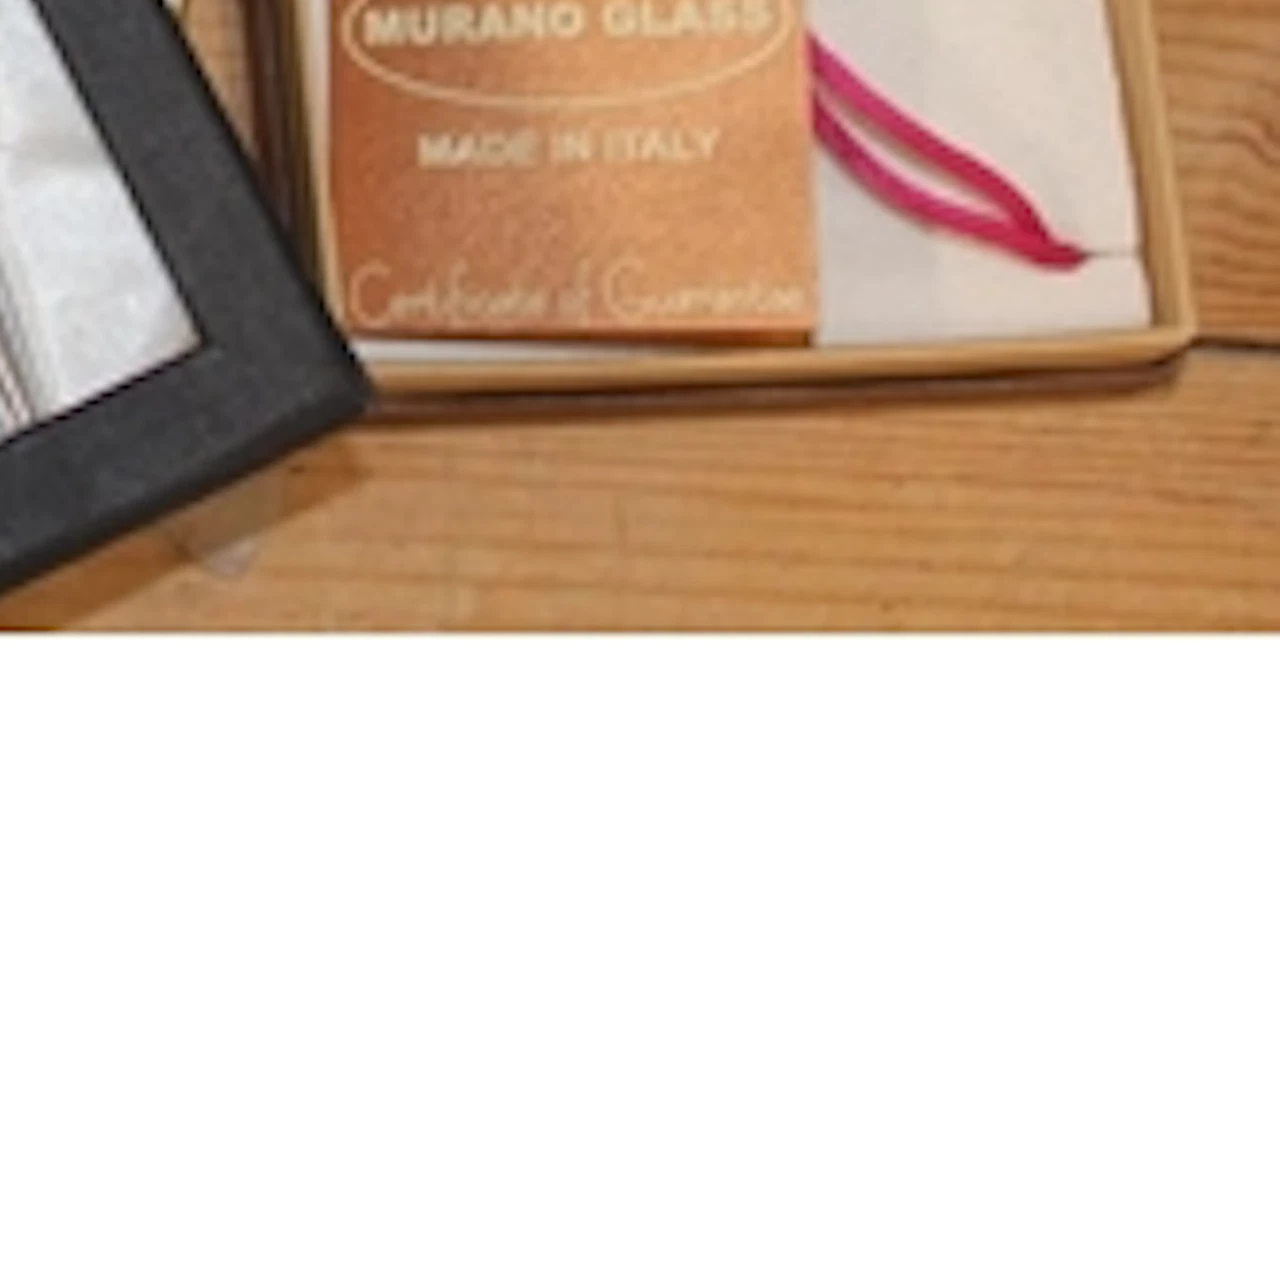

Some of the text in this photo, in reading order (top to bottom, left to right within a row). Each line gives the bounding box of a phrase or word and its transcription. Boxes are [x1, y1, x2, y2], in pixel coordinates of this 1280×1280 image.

[365, 2, 582, 48] MURANO
[417, 126, 721, 169] MADE IN ITALY
